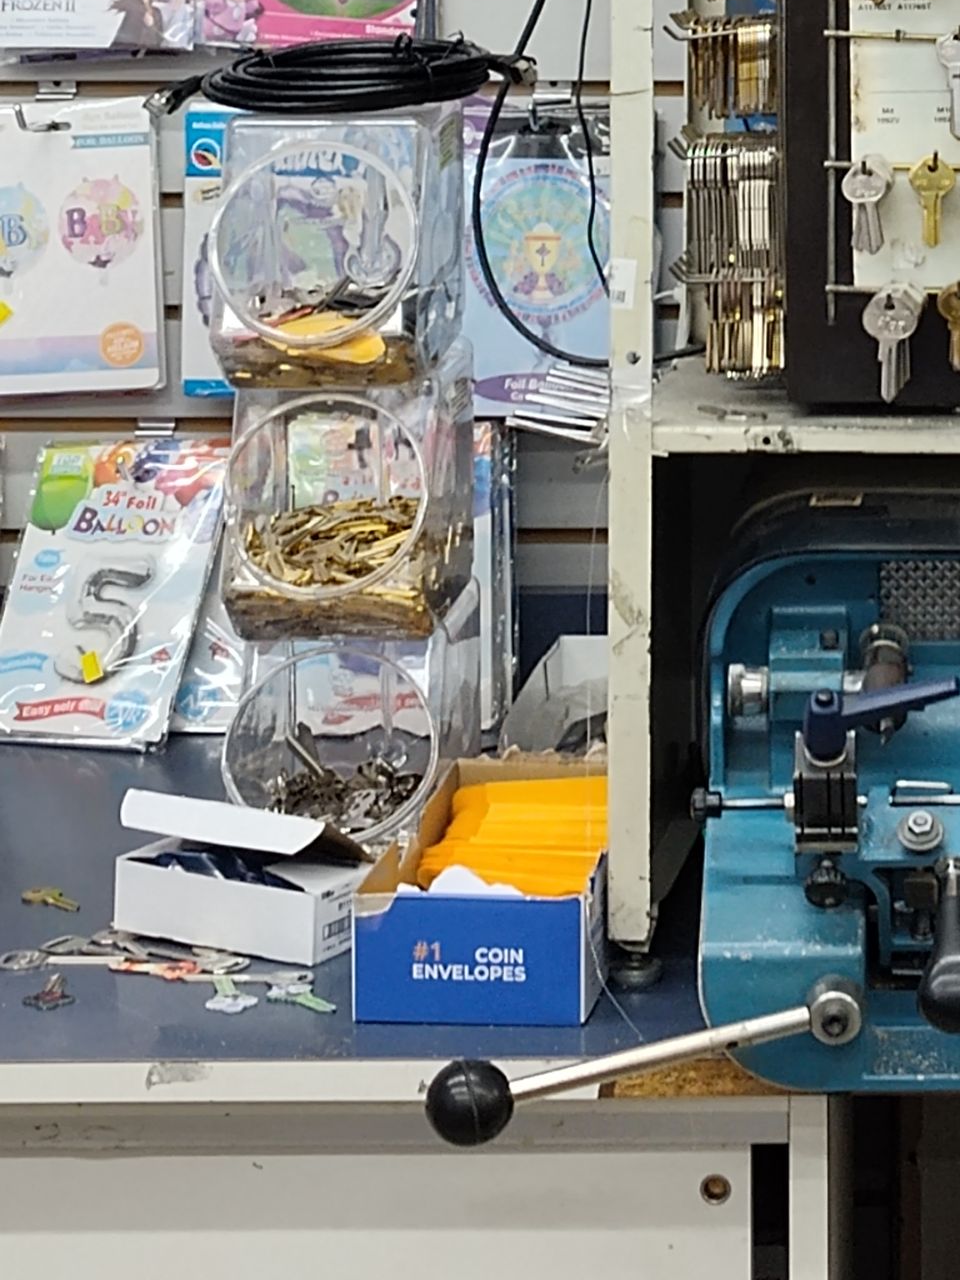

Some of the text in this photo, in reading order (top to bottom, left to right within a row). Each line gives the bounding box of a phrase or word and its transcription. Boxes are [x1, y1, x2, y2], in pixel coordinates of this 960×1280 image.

[127, 496, 157, 510] Foil
[73, 506, 177, 536] BALLOON
[22, 704, 52, 717] Easy
[412, 940, 442, 962] #1
[475, 947, 524, 965] COIN
[412, 963, 527, 983] ENVELOPES
